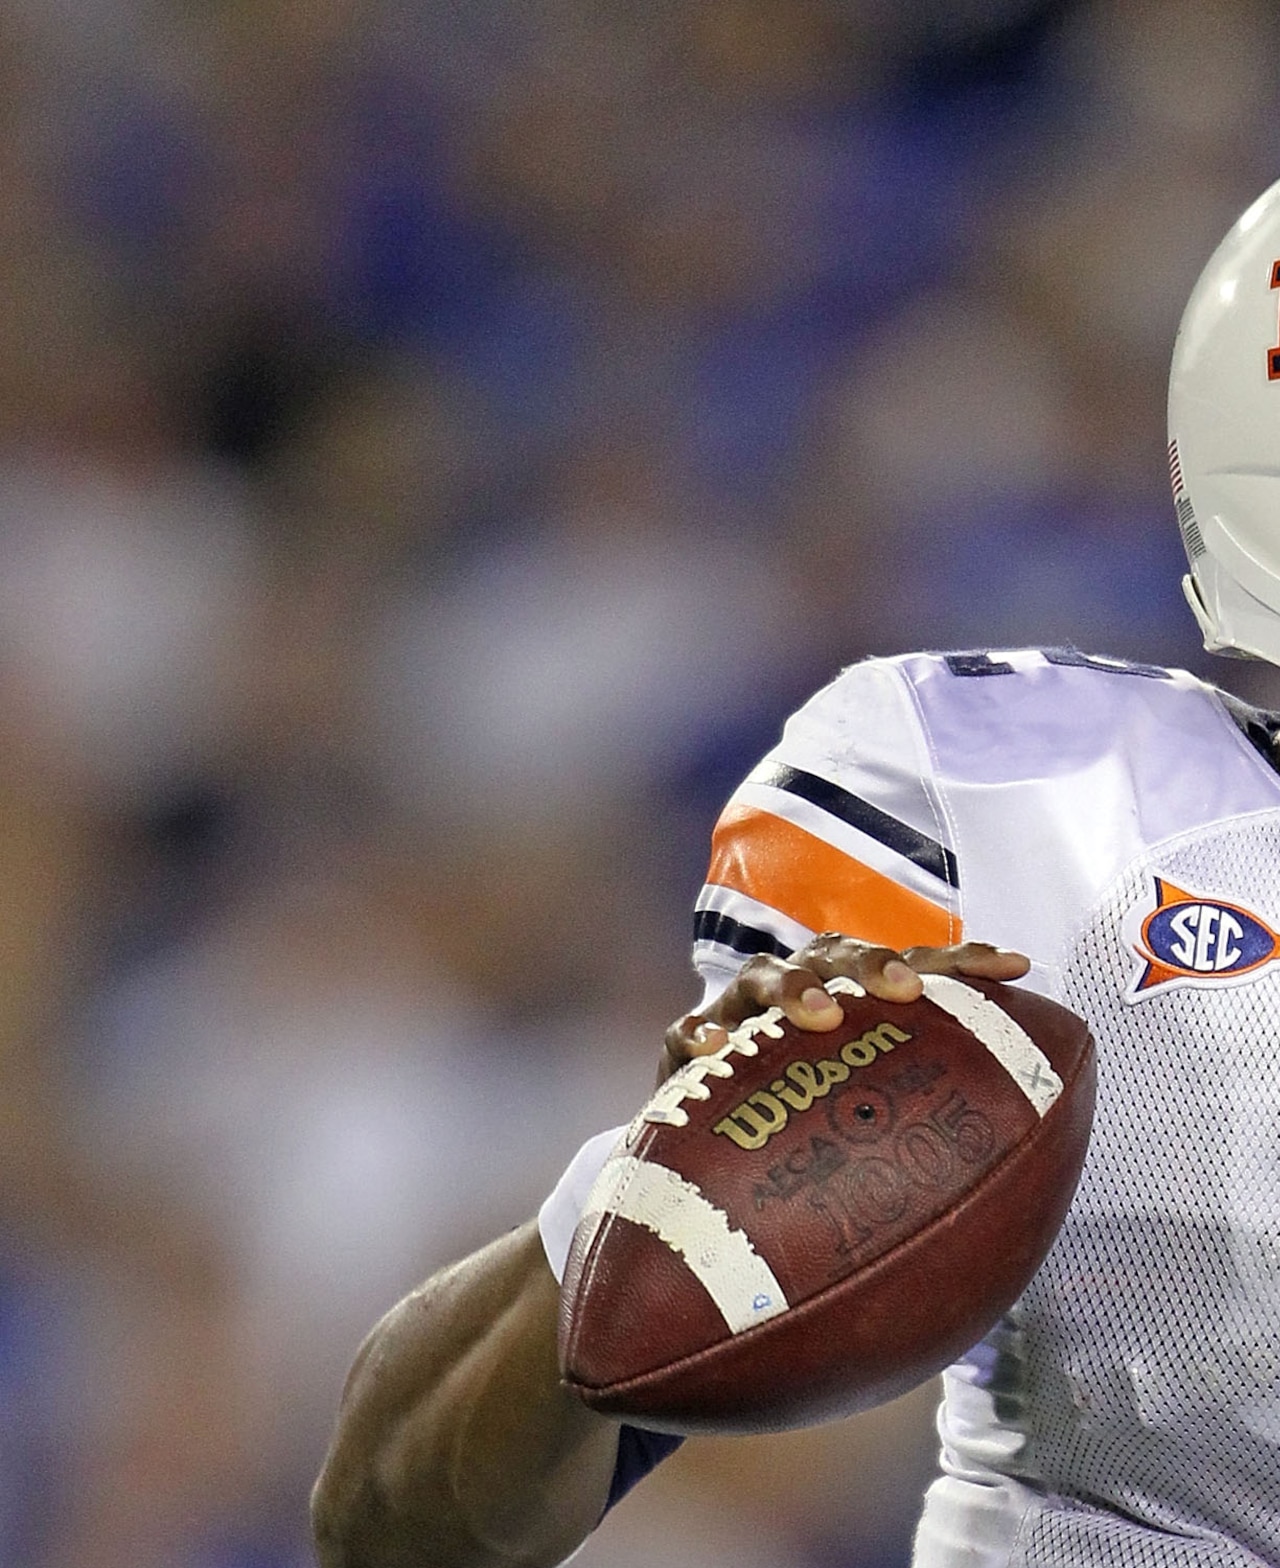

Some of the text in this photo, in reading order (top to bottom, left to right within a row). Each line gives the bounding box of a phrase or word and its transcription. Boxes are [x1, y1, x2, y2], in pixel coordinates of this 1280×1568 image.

[1170, 904, 1244, 972] SEC
[712, 1022, 913, 1150] Wilson
[808, 1087, 996, 1256] 1005
